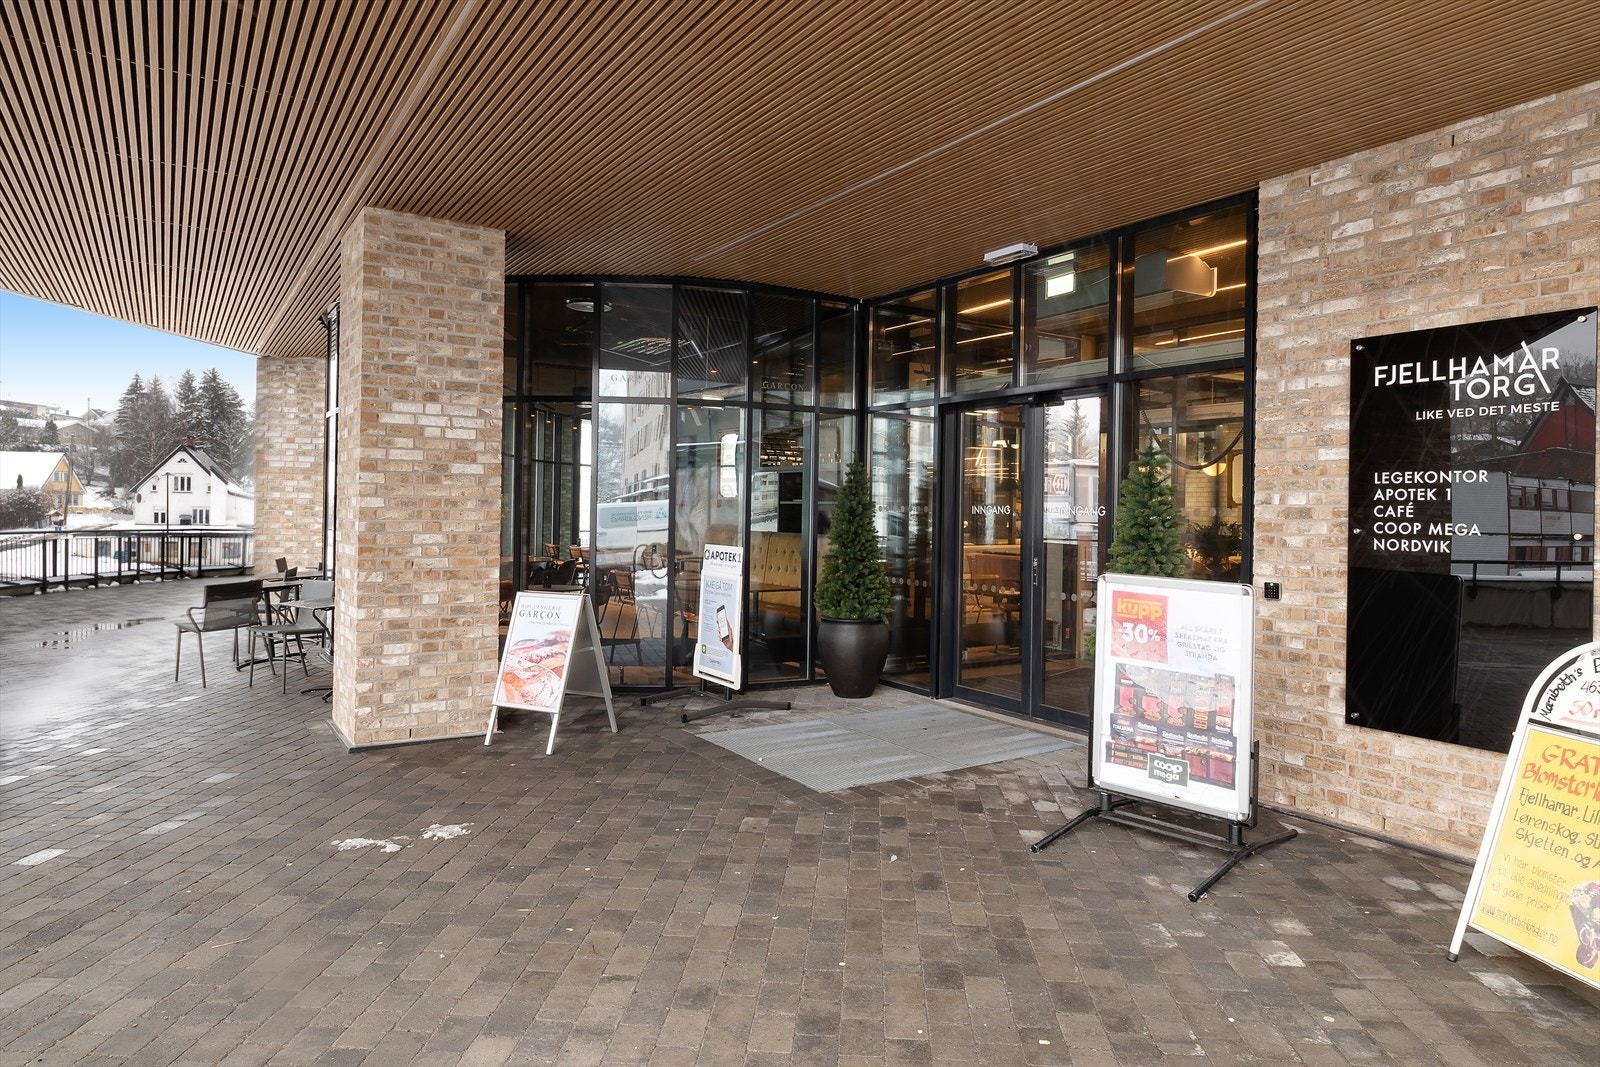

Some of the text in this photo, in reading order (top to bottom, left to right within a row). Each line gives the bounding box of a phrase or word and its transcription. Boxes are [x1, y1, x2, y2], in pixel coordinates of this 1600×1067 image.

[1374, 341, 1560, 388] FJELLHAMAR
[1449, 374, 1536, 401] TORG
[1415, 401, 1560, 420] LIKE VED DET MESTE
[1374, 470, 1489, 484] LEGEKONTOR
[1373, 488, 1451, 501] APOTEK 1
[971, 505, 1011, 515] INNGANG
[1373, 502, 1414, 518] CAFÉ
[1373, 522, 1482, 537] COOP MEGA
[1373, 538, 1451, 554] NORDVIK
[710, 550, 737, 562] APOTEK
[518, 609, 561, 620] GARÇON
[1118, 621, 1161, 645] -30%
[1153, 759, 1183, 774] coop
[1153, 769, 1180, 782] mega
[1574, 853, 1591, 869] og
